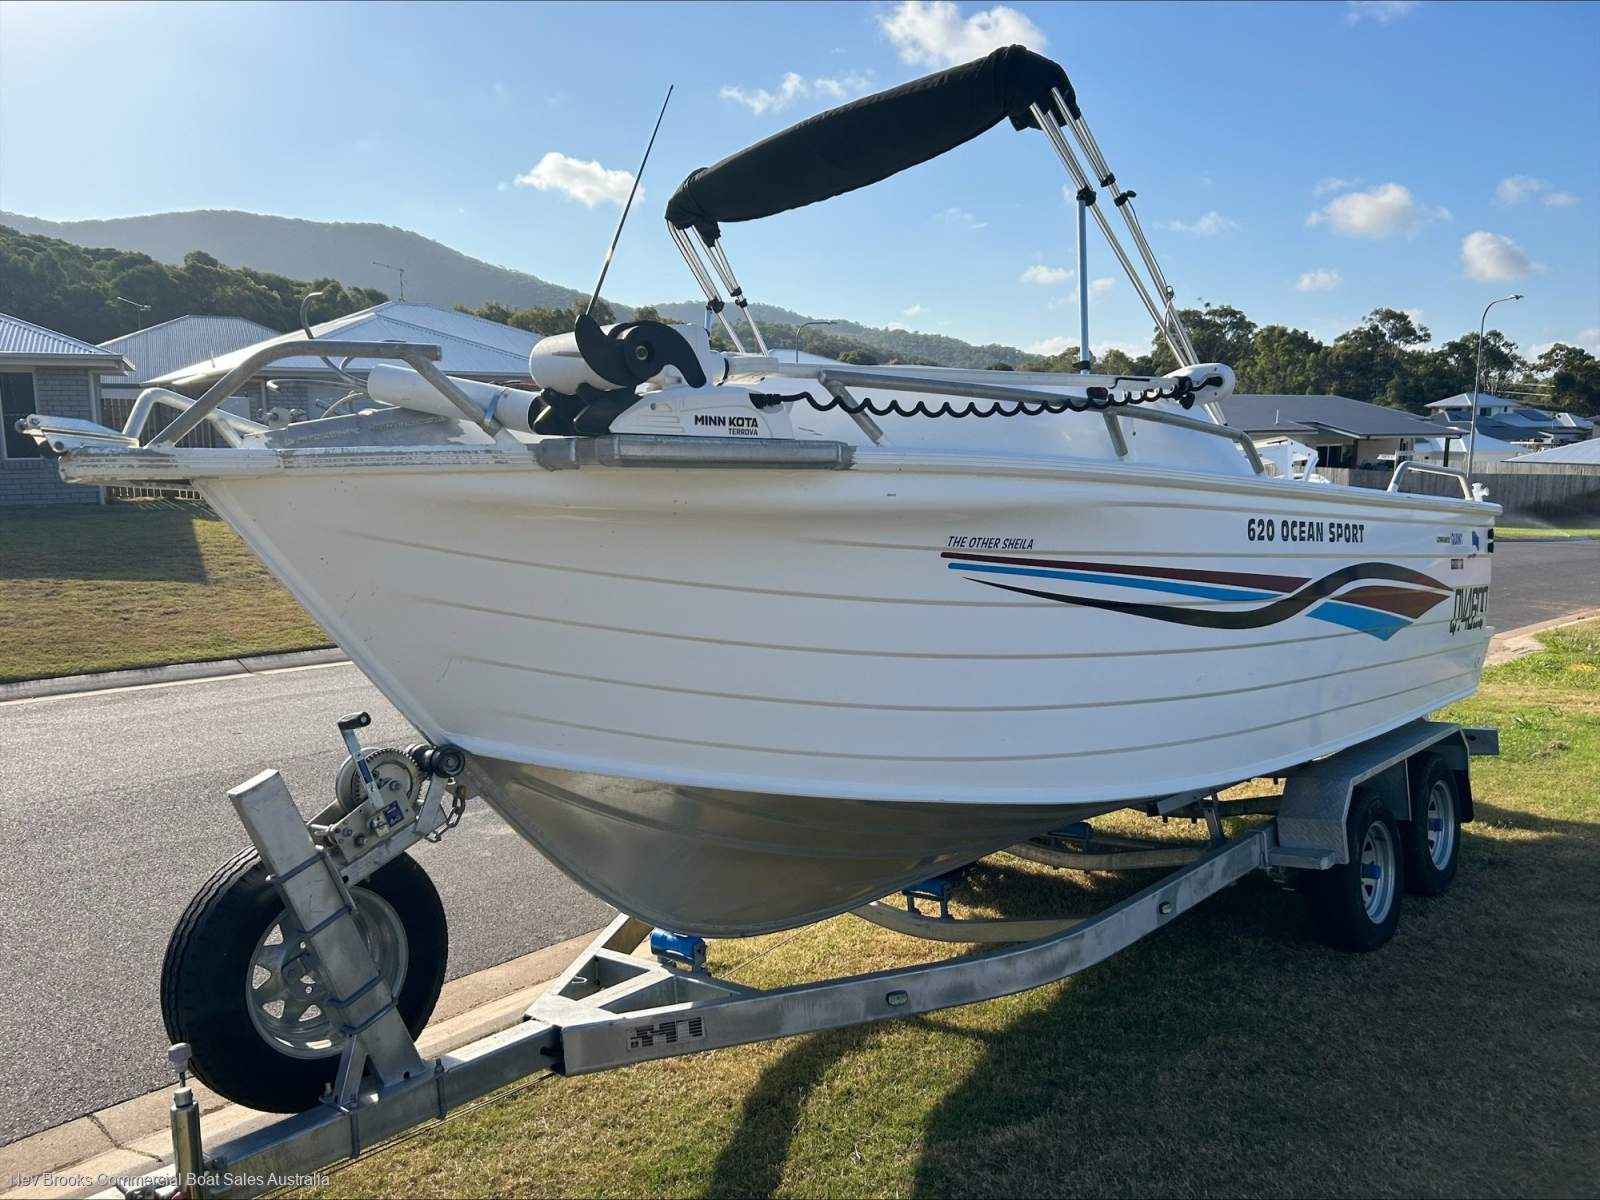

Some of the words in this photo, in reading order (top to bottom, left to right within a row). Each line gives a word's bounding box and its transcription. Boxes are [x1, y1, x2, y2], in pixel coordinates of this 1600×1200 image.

[694, 414, 726, 427] MINN
[728, 416, 758, 428] KOTA
[728, 427, 758, 436] TERROVA
[1247, 518, 1275, 542] 620
[1281, 519, 1324, 543] OCEAN
[1328, 522, 1364, 543] SPORT
[948, 535, 968, 548] THE
[968, 537, 1001, 549] OTHER
[1001, 538, 1034, 550] SHEILA
